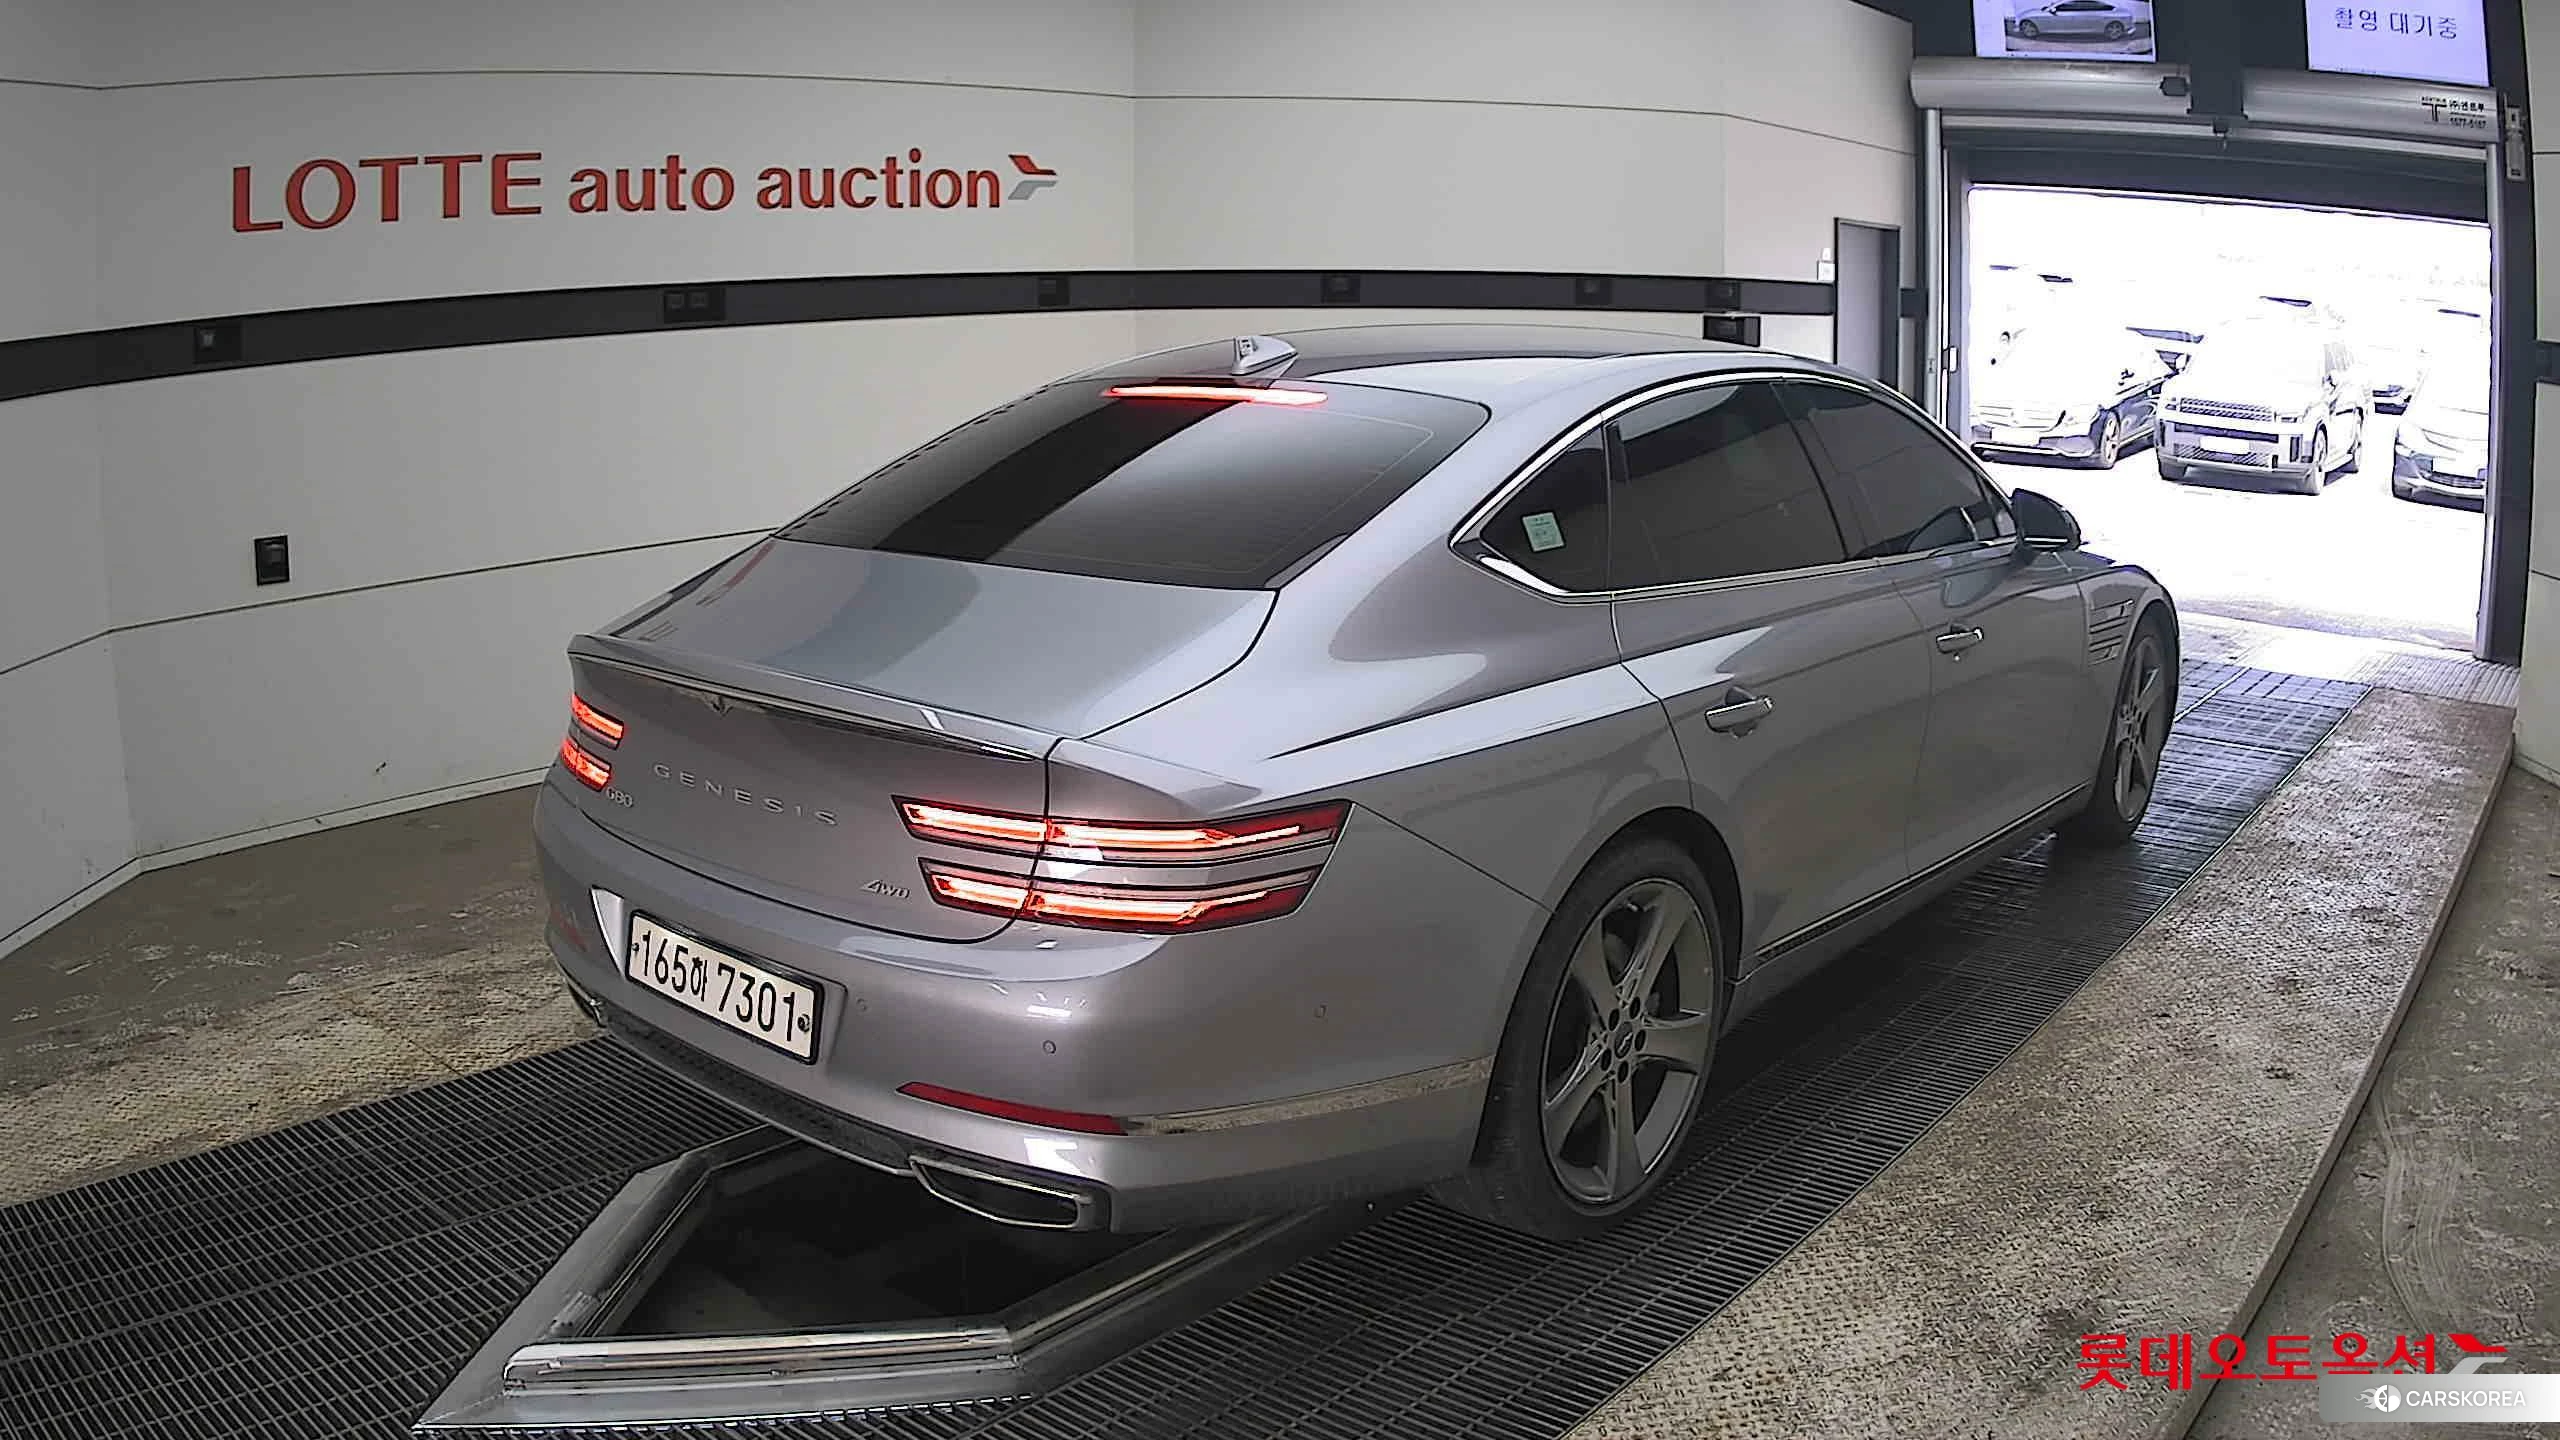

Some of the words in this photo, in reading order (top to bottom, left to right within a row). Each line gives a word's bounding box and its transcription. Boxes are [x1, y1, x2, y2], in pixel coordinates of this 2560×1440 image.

[2335, 7, 2377, 32] 촬영
[2389, 12, 2457, 40] 대기중
[232, 151, 543, 233] LOTTE
[568, 154, 735, 213] auto
[756, 147, 1001, 212] auction
[606, 786, 633, 808] G80
[653, 763, 839, 827] GENESIS
[859, 879, 911, 900] 4WD
[642, 930, 708, 1002] 165하
[717, 962, 796, 1042] 7301
